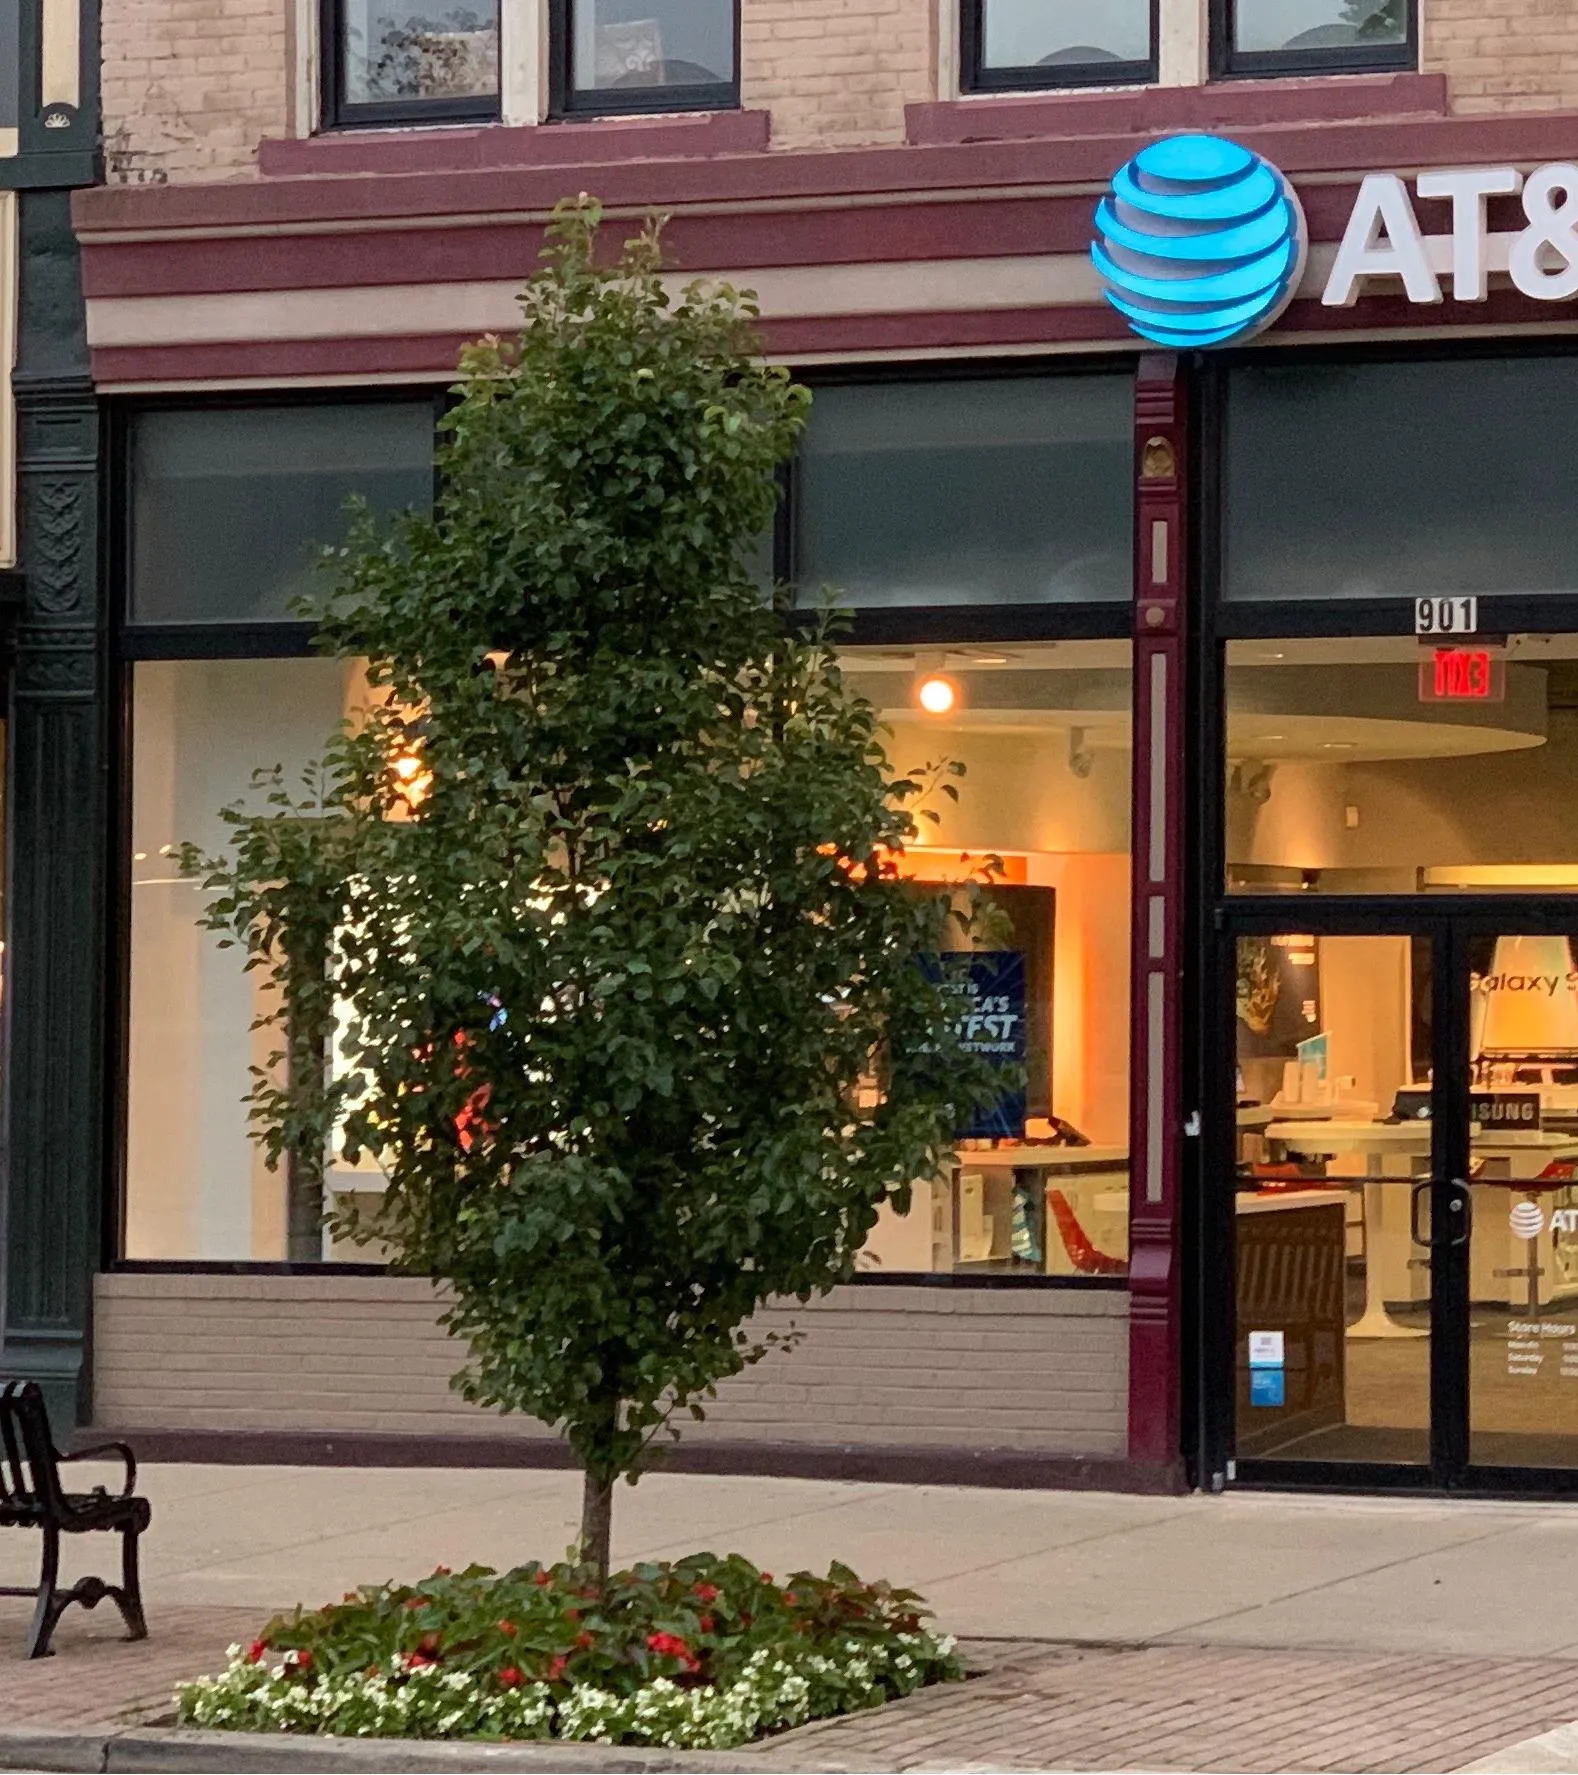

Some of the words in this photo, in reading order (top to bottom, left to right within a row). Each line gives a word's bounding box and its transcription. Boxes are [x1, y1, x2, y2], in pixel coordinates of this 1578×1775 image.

[1419, 599, 1471, 631] 901
[1471, 1102, 1534, 1121] SUNG
[1508, 1320, 1540, 1333] Store
[1541, 1322, 1576, 1336] Hours
